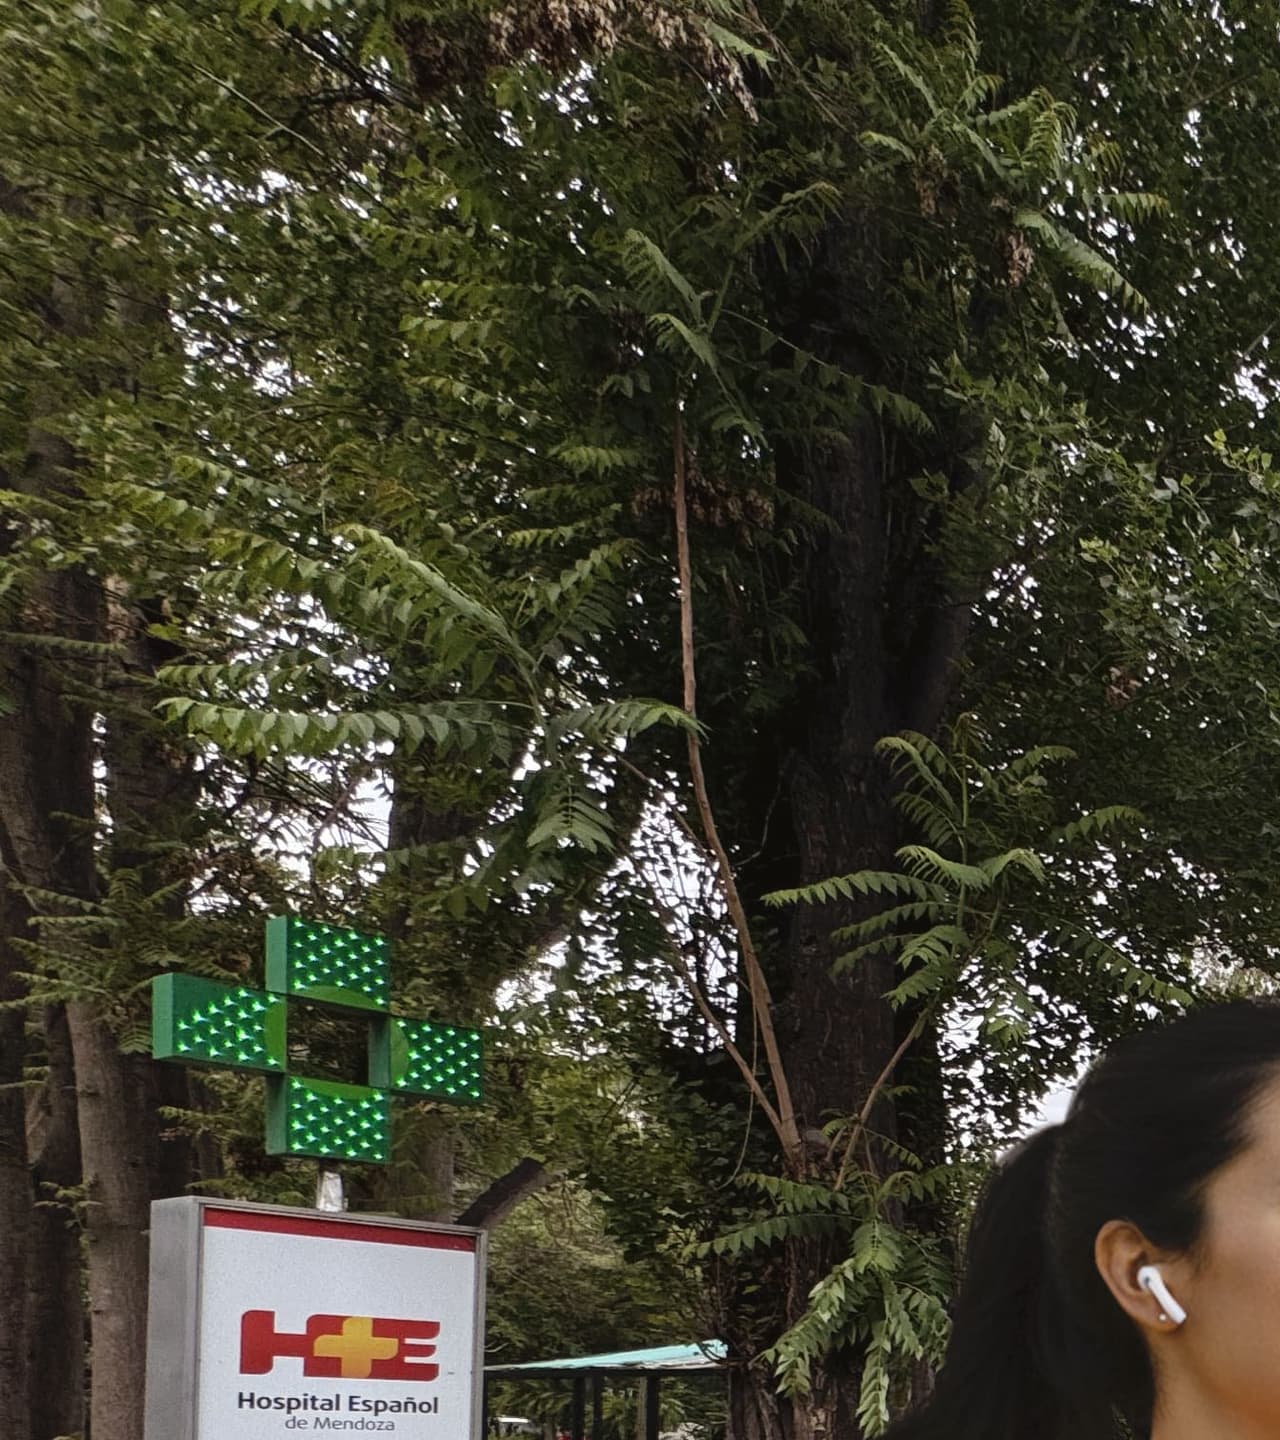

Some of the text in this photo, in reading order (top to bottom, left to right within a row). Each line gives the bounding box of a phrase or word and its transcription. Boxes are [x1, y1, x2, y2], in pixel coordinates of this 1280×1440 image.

[237, 1391, 439, 1416] Hospital Español
[284, 1416, 396, 1431] de Mendoza
